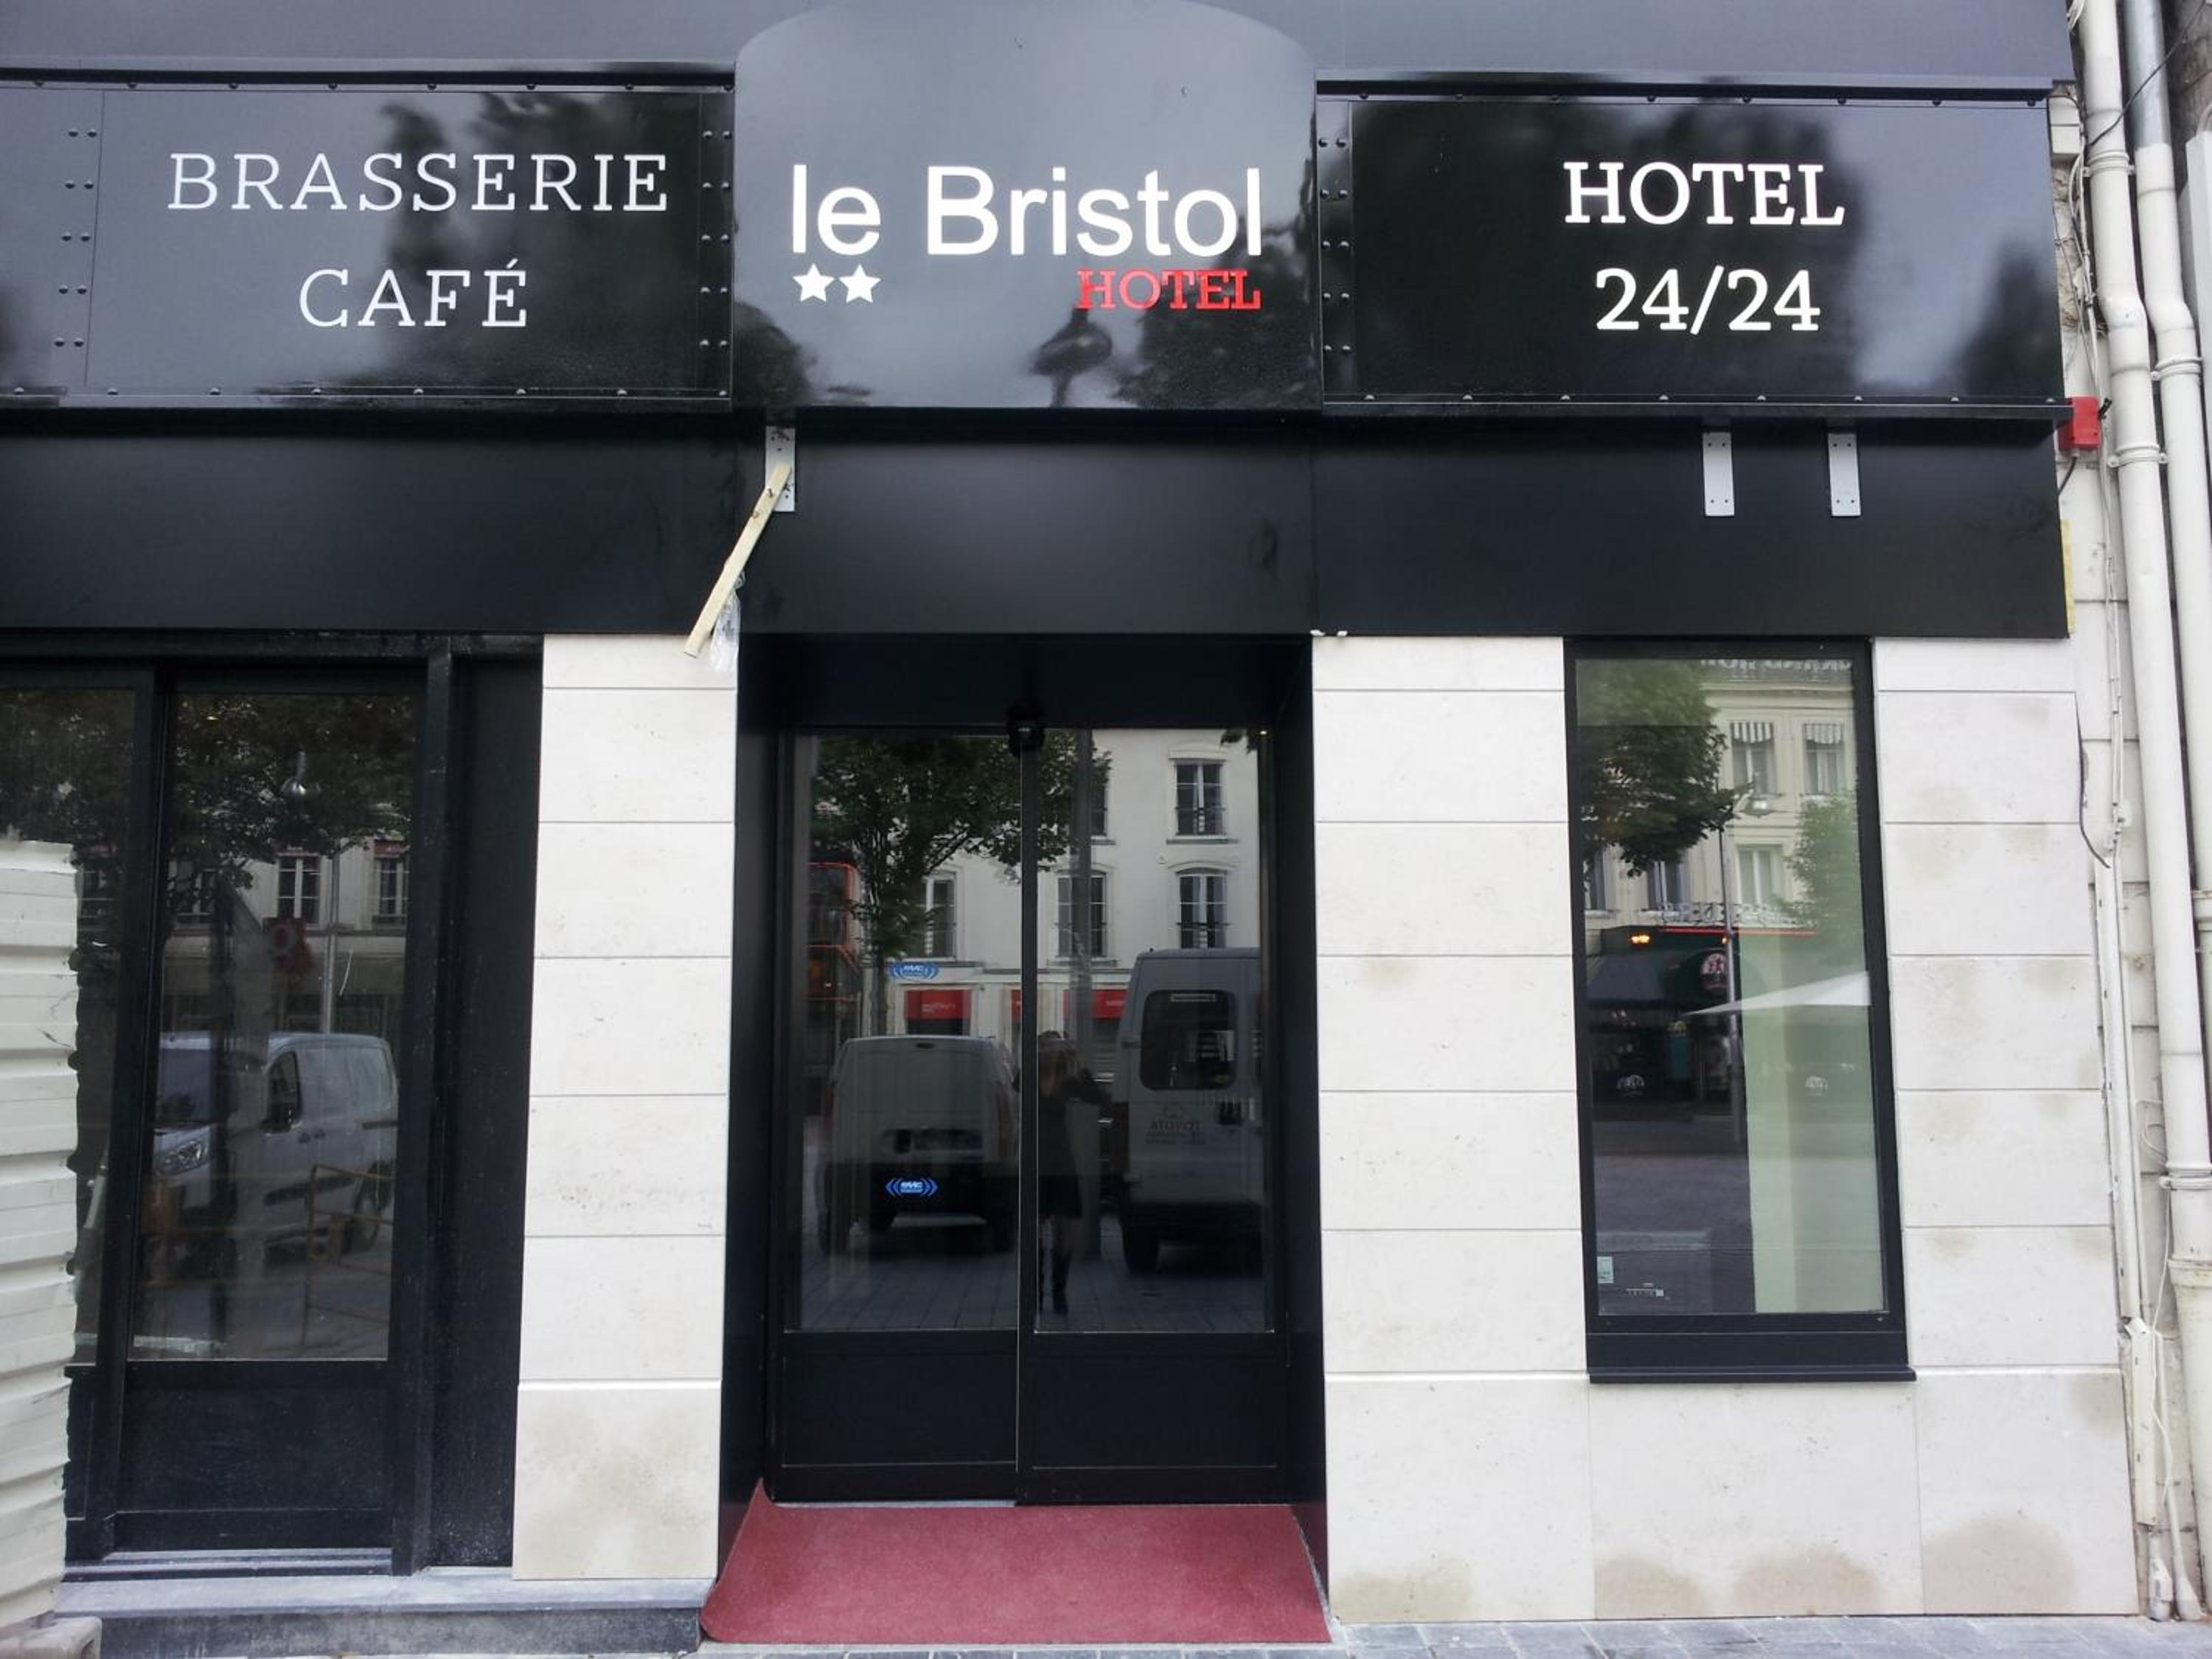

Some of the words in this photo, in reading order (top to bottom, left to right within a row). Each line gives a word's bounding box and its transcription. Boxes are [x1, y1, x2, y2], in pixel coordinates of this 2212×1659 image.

[168, 153, 667, 212] BRASSERIE
[792, 164, 882, 257] le
[926, 165, 1262, 257] Bristol
[1563, 161, 1846, 225] HOTEL
[299, 258, 528, 327] CAFÉ
[1077, 268, 1262, 311] HOTEL
[1596, 265, 1821, 335] 24/24
